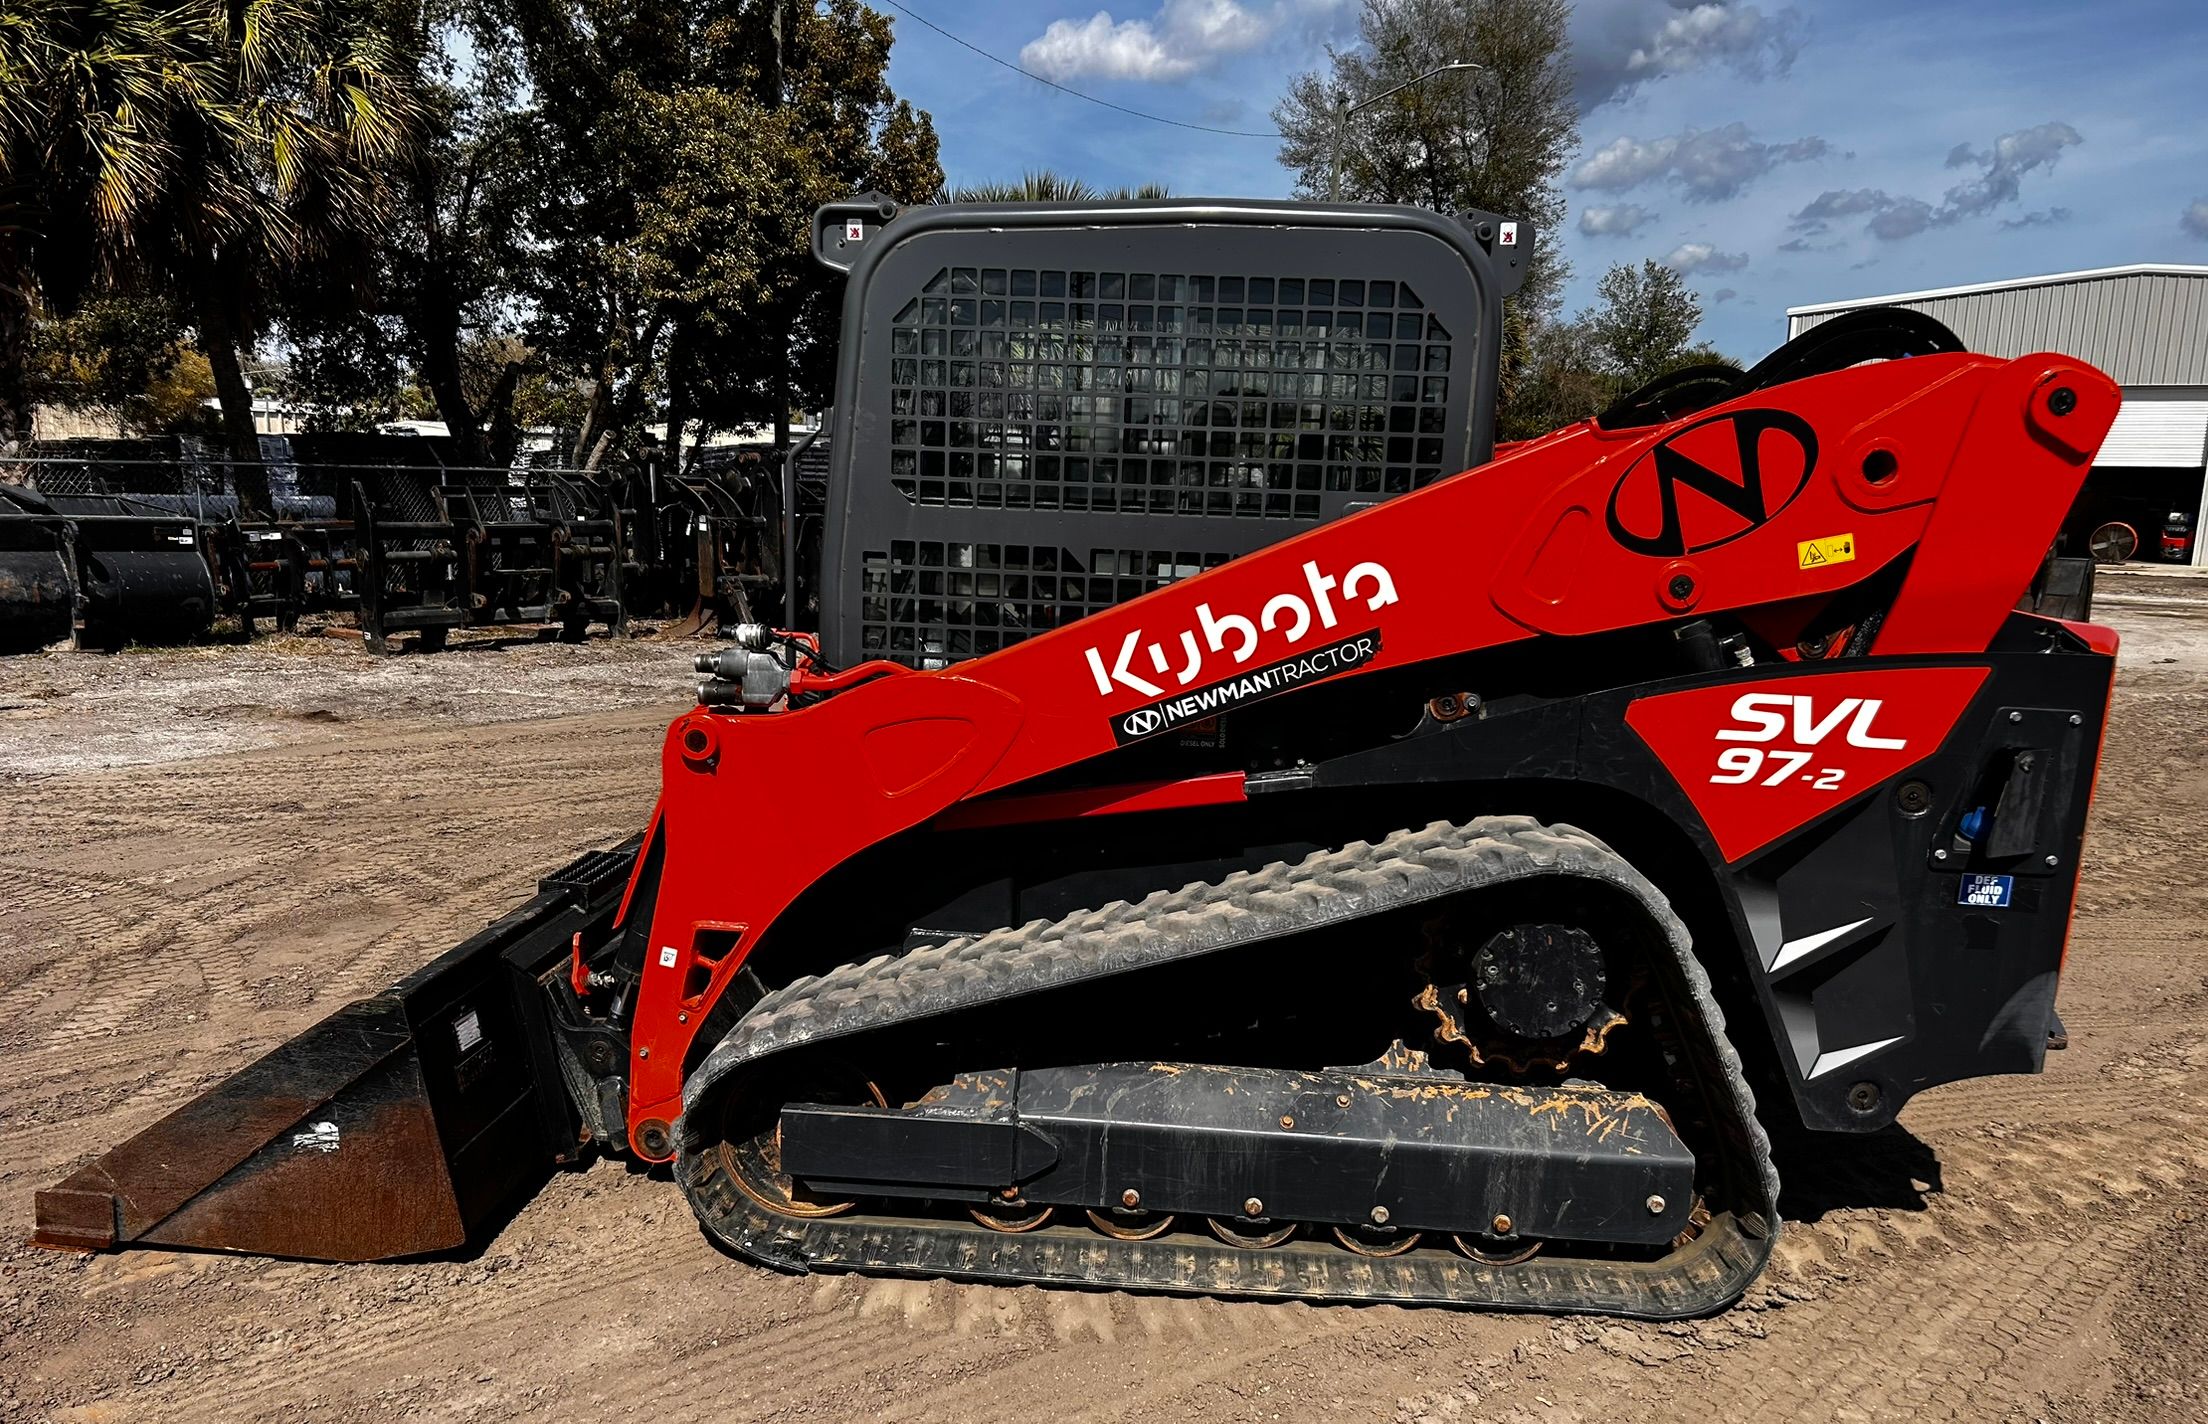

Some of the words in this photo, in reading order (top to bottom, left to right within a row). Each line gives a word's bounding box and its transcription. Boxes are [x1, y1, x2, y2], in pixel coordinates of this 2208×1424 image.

[1085, 560, 1399, 697] Kubota
[1715, 692, 1907, 750] SVL
[1709, 747, 1846, 791] 97-2
[1967, 884, 2003, 895] FLUID
[1974, 875, 1999, 885] DEF
[1967, 893, 2000, 905] ONLY
